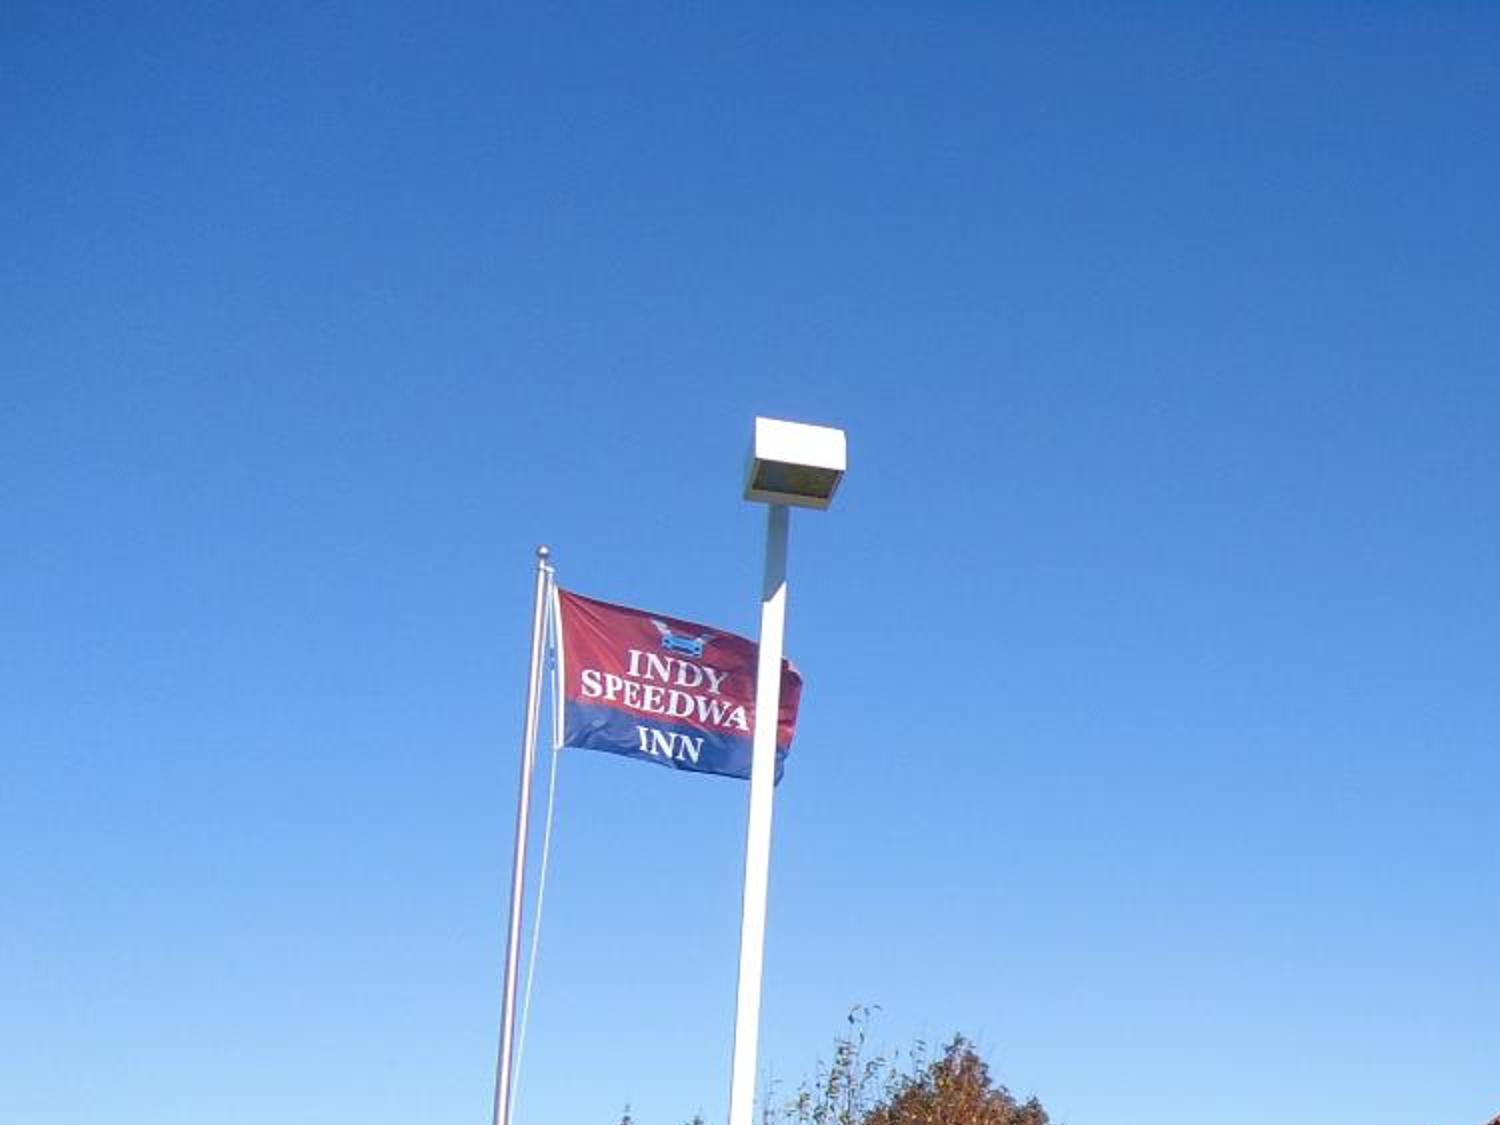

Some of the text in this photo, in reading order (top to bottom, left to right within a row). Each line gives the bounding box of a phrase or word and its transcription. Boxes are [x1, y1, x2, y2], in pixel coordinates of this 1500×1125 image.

[627, 650, 728, 695] INDY
[581, 669, 750, 731] SPEEDWA
[637, 725, 704, 763] INN
